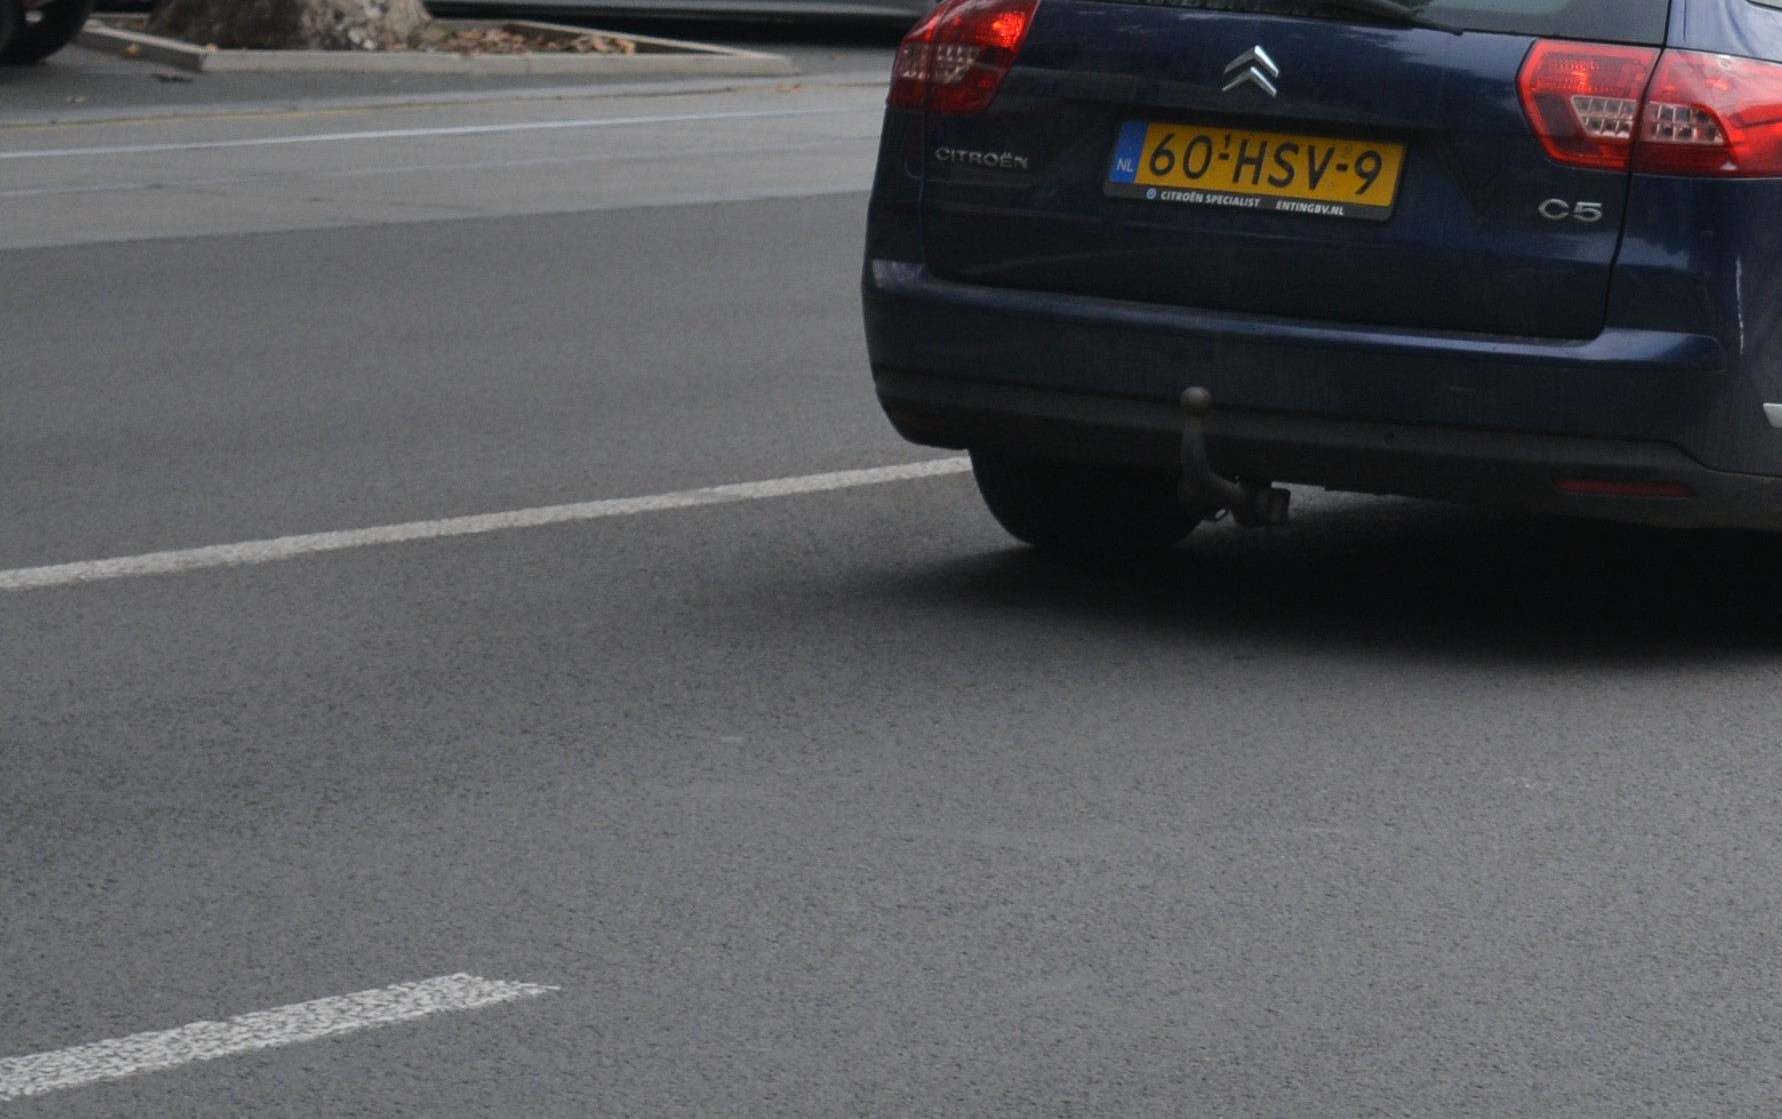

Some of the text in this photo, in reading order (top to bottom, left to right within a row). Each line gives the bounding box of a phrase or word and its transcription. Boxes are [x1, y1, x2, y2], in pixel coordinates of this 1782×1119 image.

[935, 146, 1028, 169] CITROËN
[1116, 158, 1134, 172] NL
[1161, 190, 1345, 216] CITROËN SPECIALIST ENTINGBV.NL
[1538, 198, 1602, 222] C5
